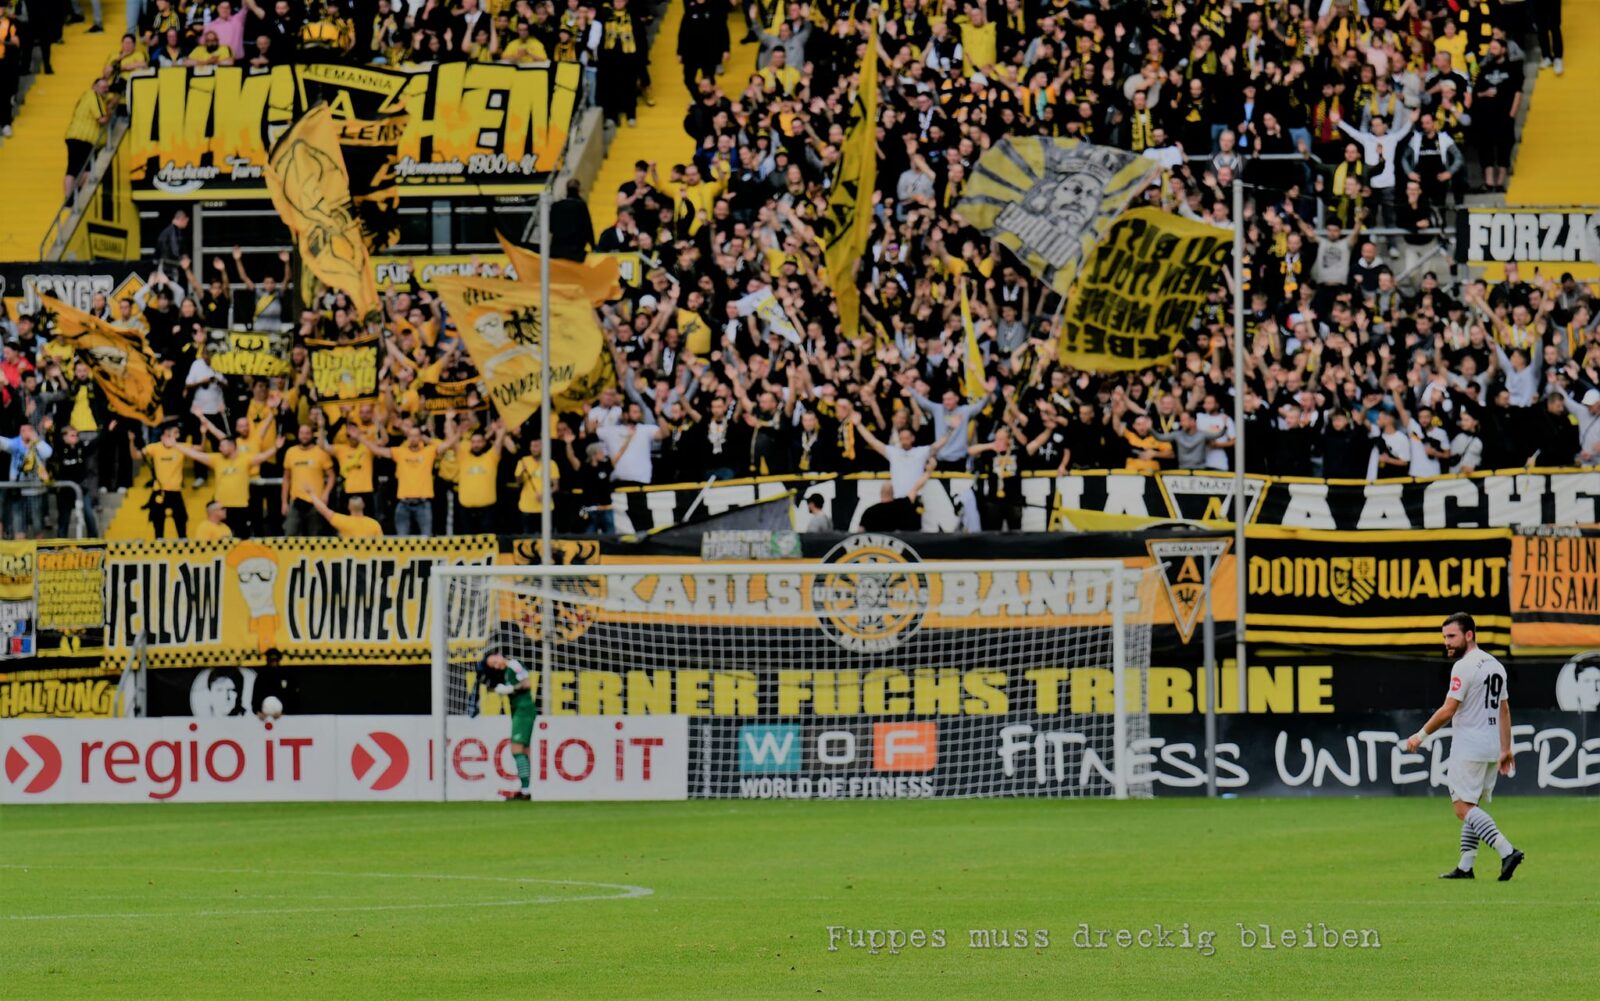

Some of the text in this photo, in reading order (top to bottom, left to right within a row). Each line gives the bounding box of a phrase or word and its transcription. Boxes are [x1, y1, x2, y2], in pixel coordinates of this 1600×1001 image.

[393, 156, 465, 176] Alemannia
[467, 153, 508, 174] 1900
[1468, 212, 1589, 262] FORZA
[1524, 537, 1597, 573] FREUN
[102, 559, 222, 647] YELLOW
[286, 555, 494, 642] CONNECTON
[604, 568, 1143, 617] KARLS BANDE
[1519, 574, 1598, 611] ZUSAM
[1, 679, 111, 718] HALTUNG
[778, 668, 1009, 716] FUCHS
[1025, 658, 1335, 716] TRIBÜNE
[1483, 673, 1504, 710] 19
[80, 723, 246, 799] regio
[998, 724, 1250, 788] FITNESS
[740, 775, 934, 798] WORLD OF FITNESS
